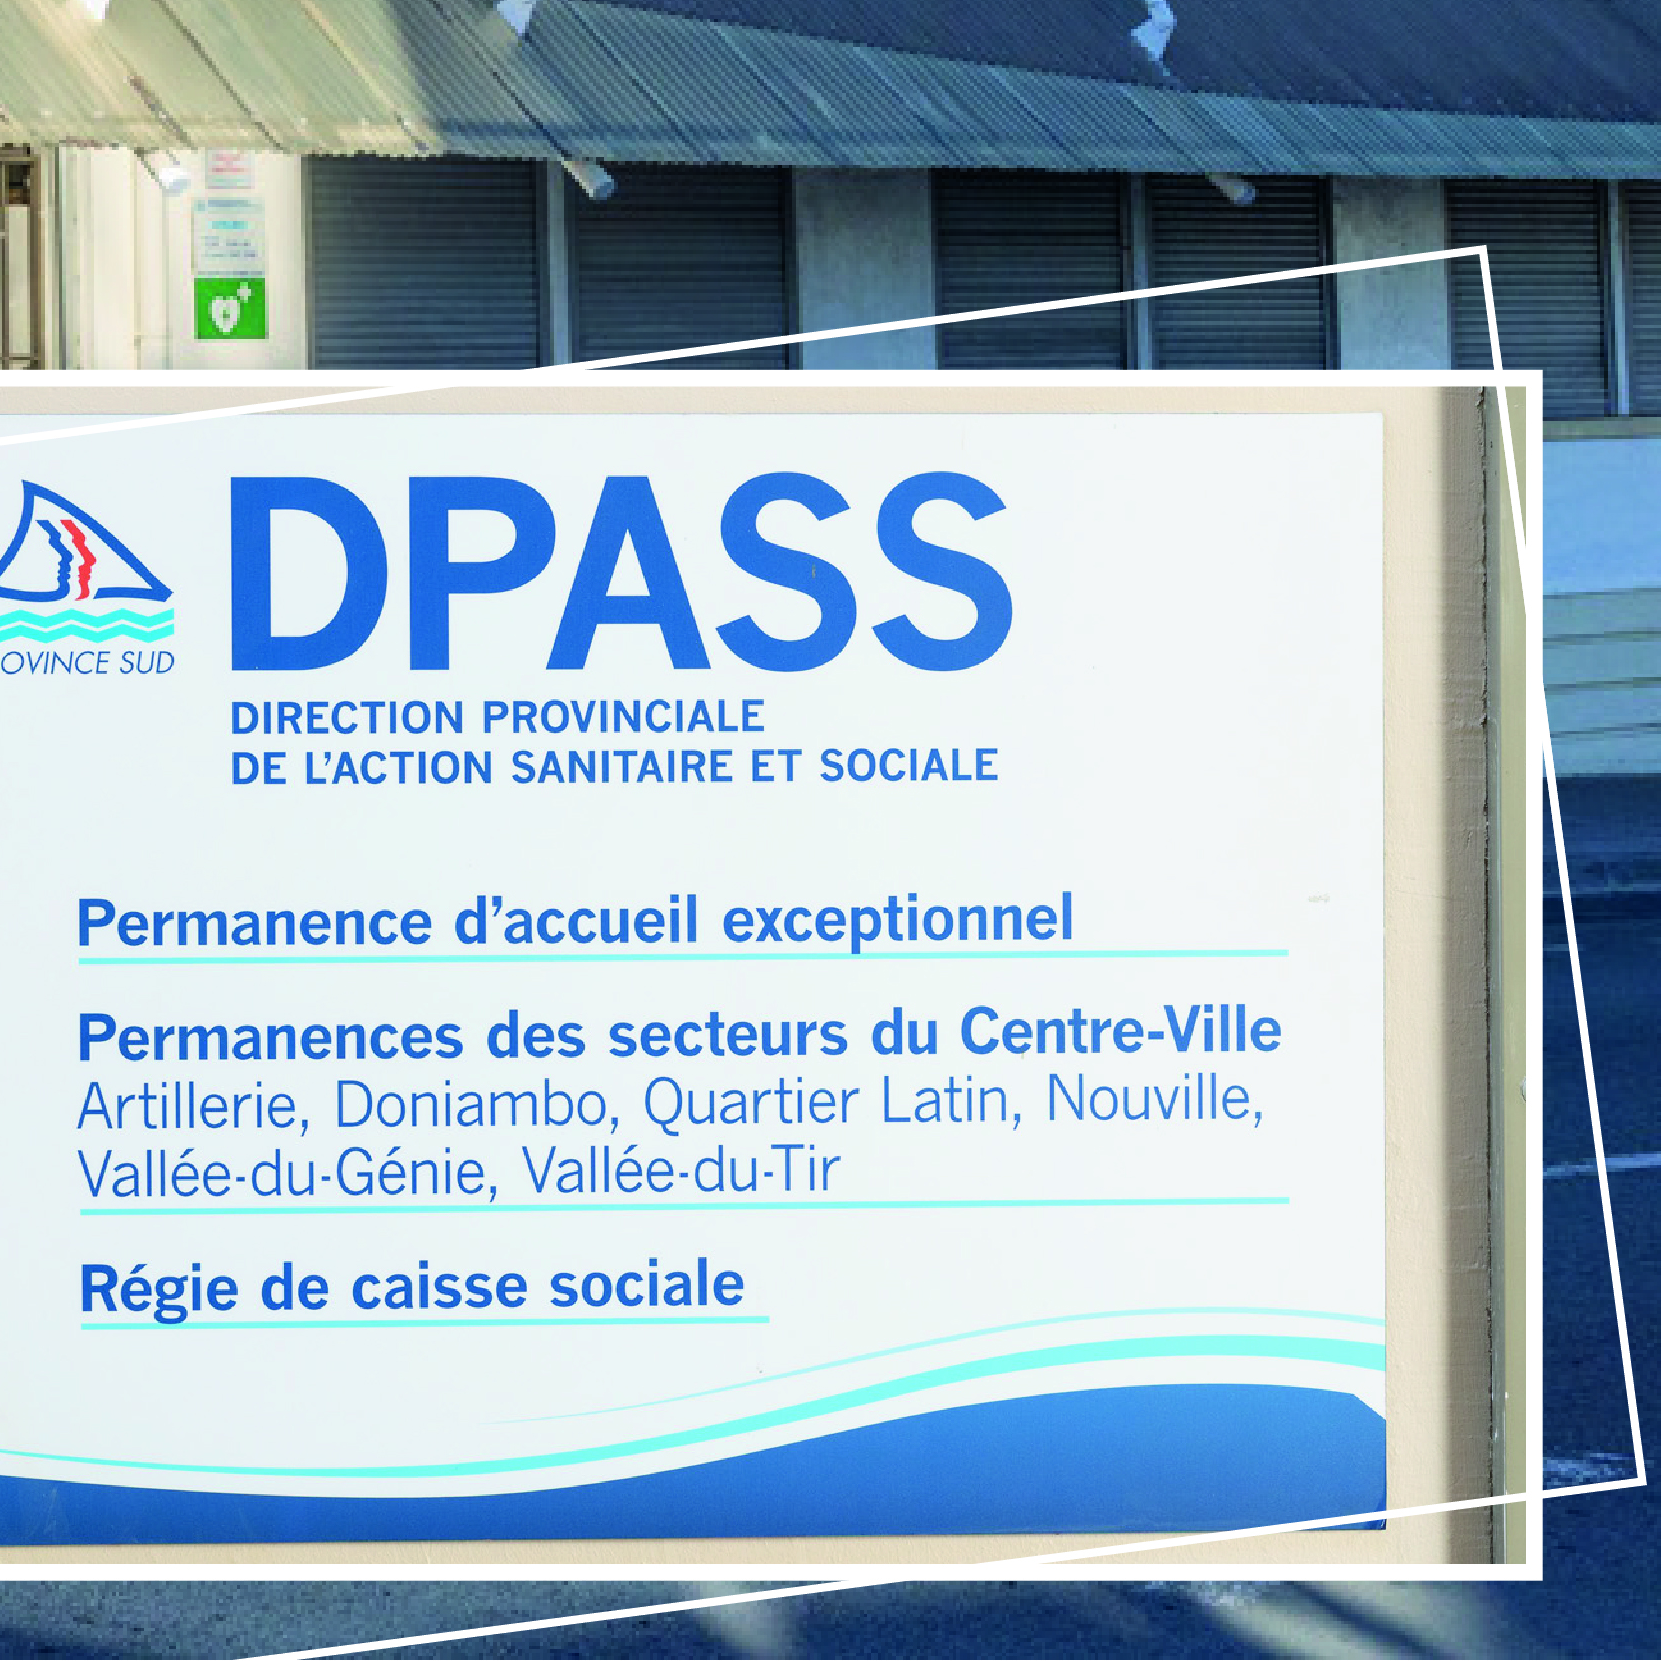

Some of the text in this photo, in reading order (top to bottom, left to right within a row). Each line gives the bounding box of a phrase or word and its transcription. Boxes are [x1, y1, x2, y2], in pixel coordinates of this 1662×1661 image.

[231, 471, 1012, 672] DPASS
[120, 650, 175, 675] SUD
[232, 698, 764, 735] DIRECTION PROVINCIALE
[232, 747, 998, 785] DE L’ACTION SANITAIRE ET SOCIALE
[79, 891, 1072, 954] Permanence d’accueil exceptionnel
[80, 1004, 1282, 1062] Permanences des secteurs du Centre-Ville
[78, 1072, 1263, 1137] Artillerie, Doniambo, Quartier Latin, Nouville,
[78, 1143, 842, 1203] Vallée-du-Génie, Vallée-du-Tir
[81, 1256, 744, 1324] Régie de caisse sociale
